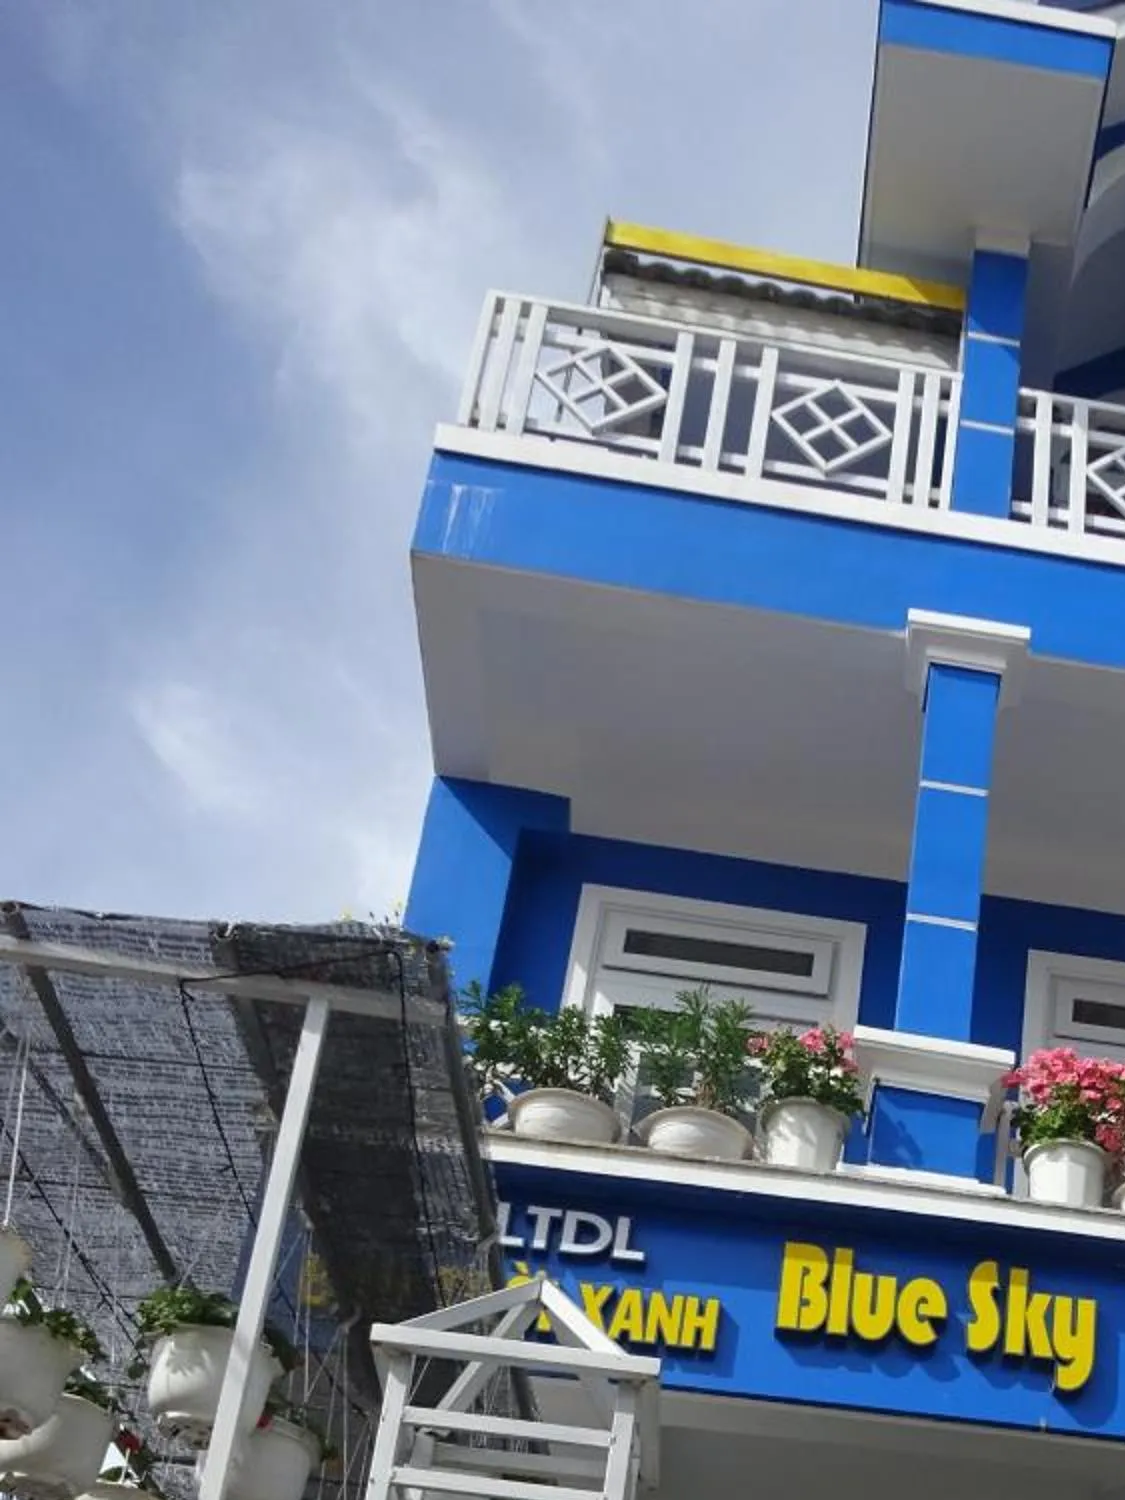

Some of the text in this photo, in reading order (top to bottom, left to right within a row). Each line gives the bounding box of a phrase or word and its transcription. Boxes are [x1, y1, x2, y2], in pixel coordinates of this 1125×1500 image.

[497, 1201, 645, 1261] LTDL
[580, 1282, 719, 1350] XANH
[776, 1241, 1096, 1391] Blue Sky
